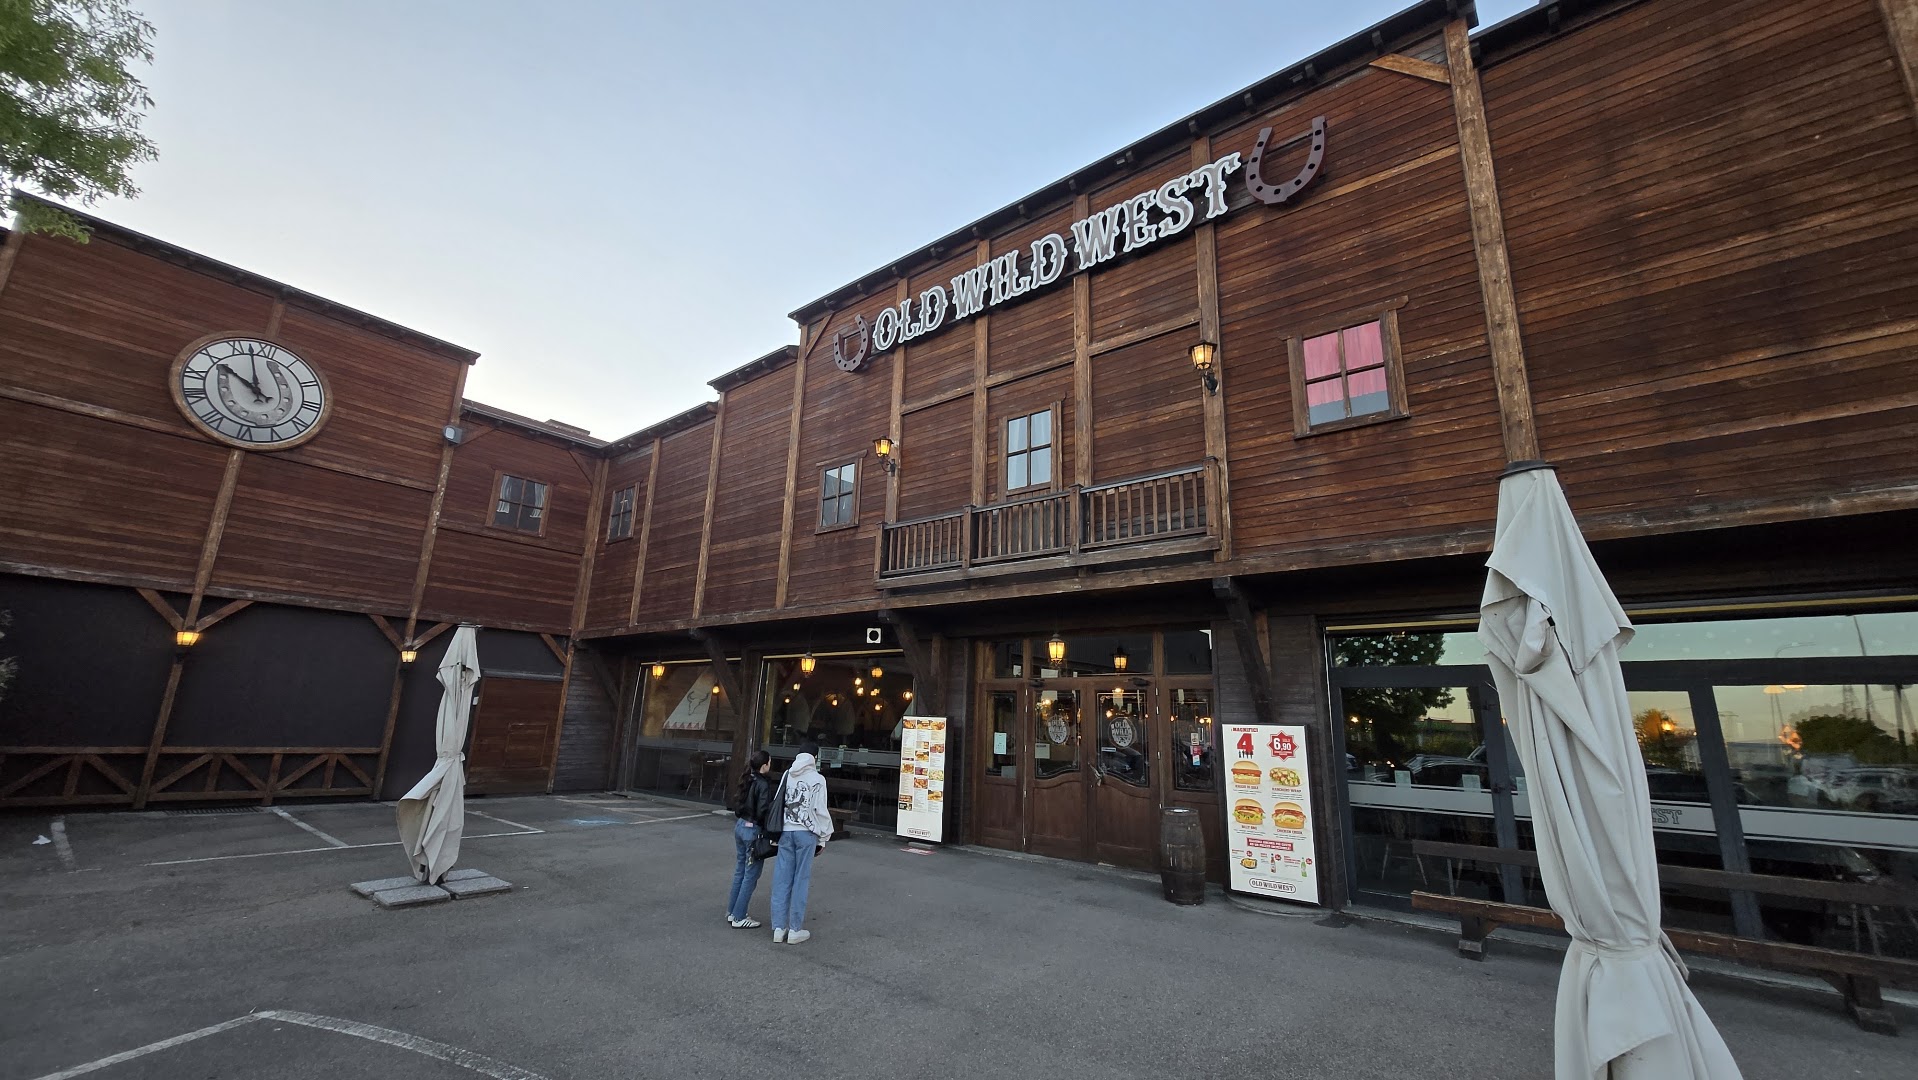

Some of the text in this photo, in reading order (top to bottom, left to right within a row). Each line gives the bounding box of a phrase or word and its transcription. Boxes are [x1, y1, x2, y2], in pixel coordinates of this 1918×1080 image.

[872, 151, 1242, 351] OLD WILD WEST
[225, 340, 245, 355] XI
[256, 342, 278, 359] XII
[199, 349, 222, 364] X
[302, 400, 320, 413] III
[1113, 728, 1130, 736] WILD
[1115, 721, 1128, 729] OLD
[1237, 733, 1255, 755] 4
[1273, 737, 1292, 751] 6,90
[1278, 884, 1293, 892] WEST
